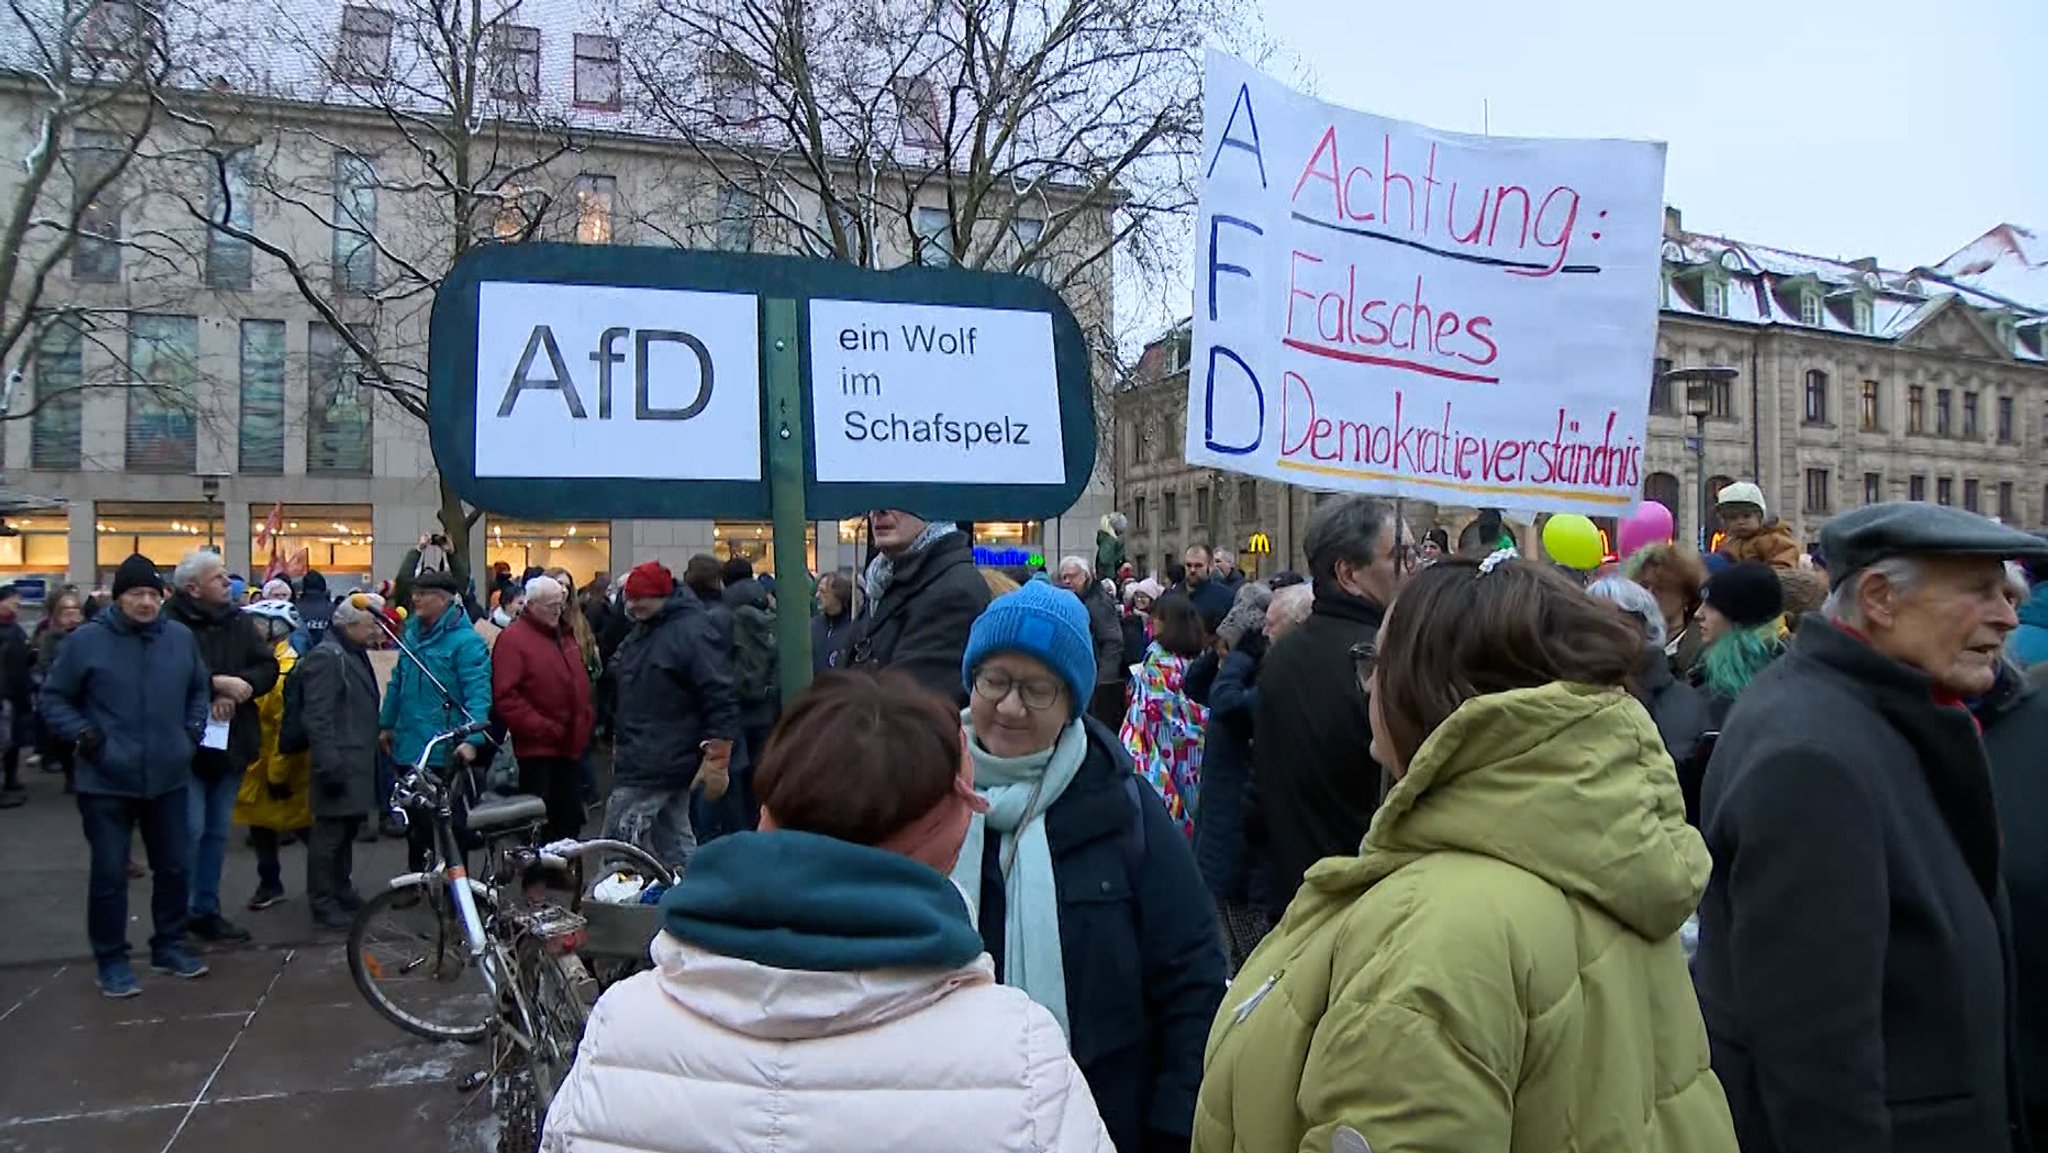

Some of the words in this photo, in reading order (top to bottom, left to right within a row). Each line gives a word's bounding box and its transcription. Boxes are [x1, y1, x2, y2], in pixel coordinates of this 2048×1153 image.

[1206, 82, 1267, 189] A
[1291, 125, 1608, 278] Achtung:
[1209, 214, 1263, 321] F
[1287, 250, 1498, 366] Falsches
[497, 325, 714, 421] AfD
[840, 323, 888, 352] ein
[902, 325, 977, 356] Wolf
[842, 367, 881, 396] im
[845, 411, 1030, 451] Schafspelz
[1204, 345, 1265, 455] D
[1280, 371, 1640, 489] Demokratieverständnis
